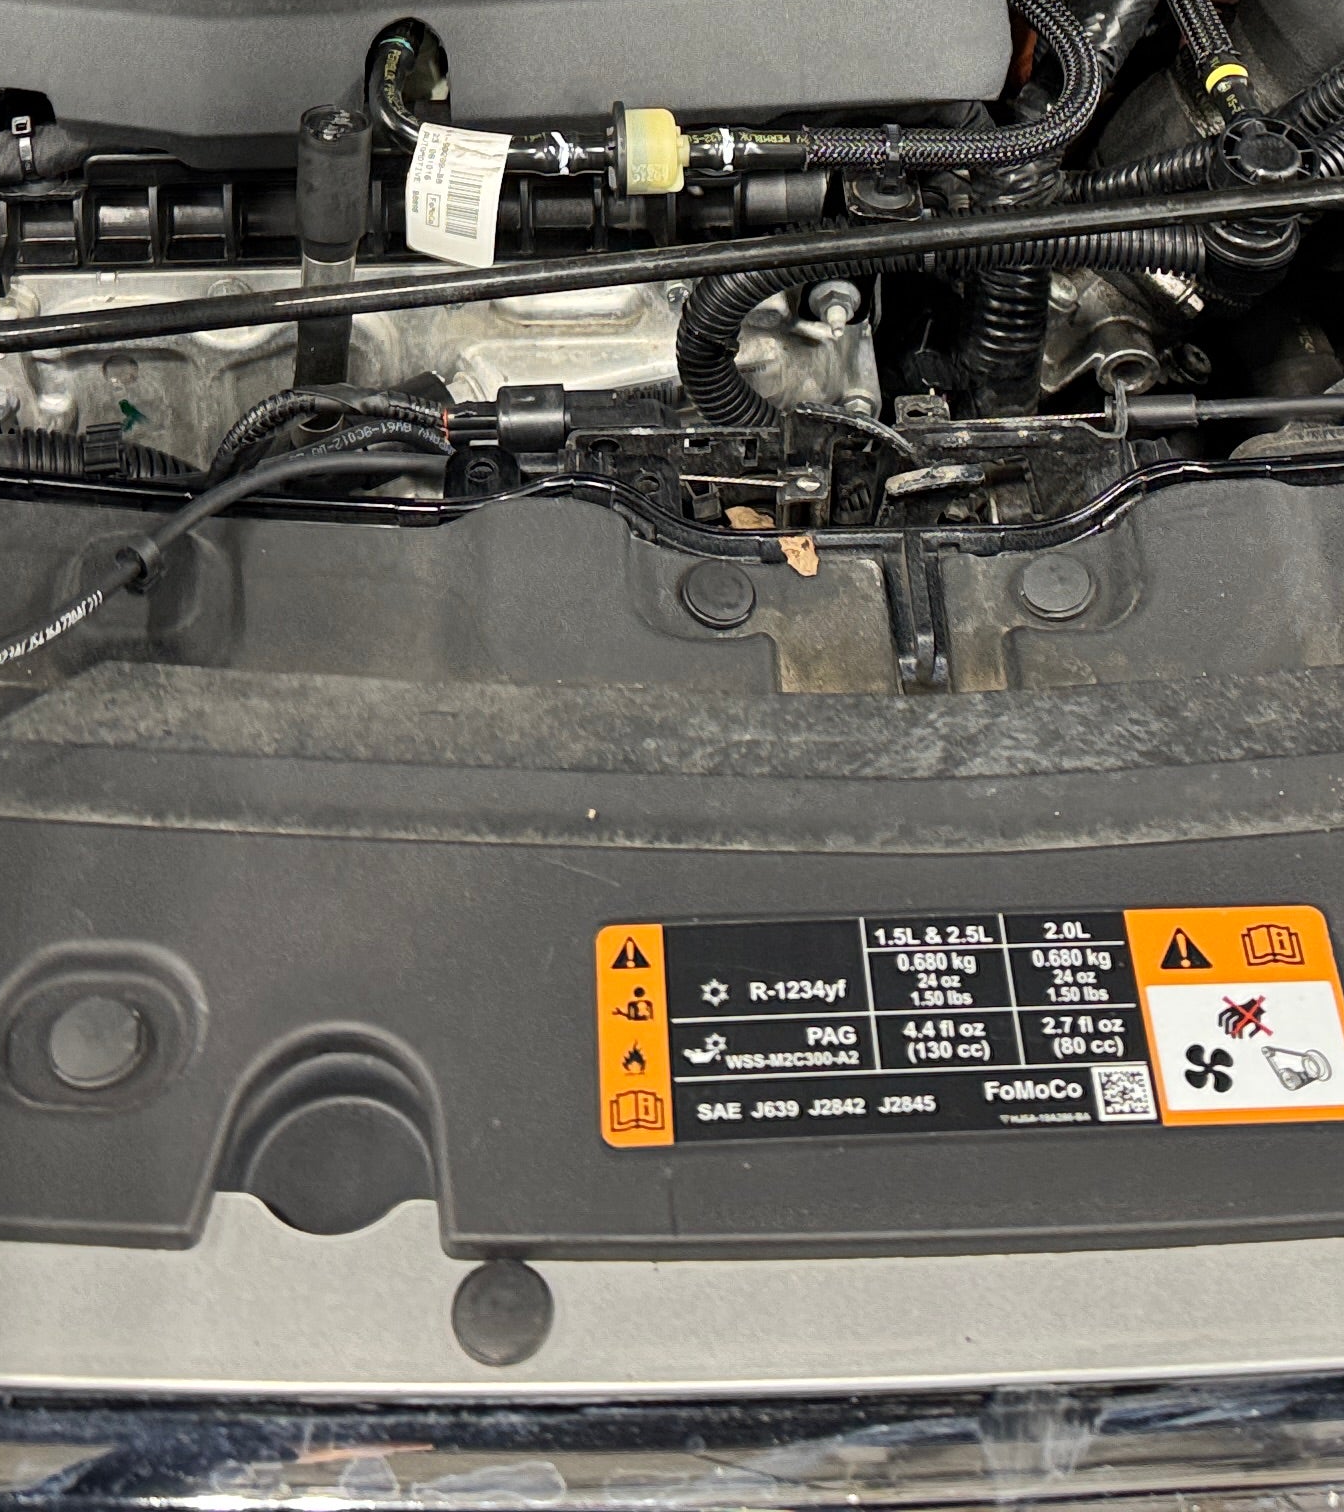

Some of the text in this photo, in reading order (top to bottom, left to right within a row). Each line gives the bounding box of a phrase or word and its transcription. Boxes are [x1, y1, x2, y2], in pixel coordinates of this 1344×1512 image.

[874, 926, 993, 946] 1.5L & 2.5L
[1043, 921, 1091, 939] 2.0L
[896, 951, 977, 974] 0.680 kg
[1031, 948, 1112, 970] 0.680 kg
[917, 973, 961, 989] 24 oz
[1052, 969, 1097, 985] 24 oz
[749, 979, 847, 1003] R-1234yf
[910, 989, 973, 1006] 1.50 lbs
[1046, 985, 1109, 1002] 1.50 lbs
[903, 1020, 986, 1038] 4.4 fl oz
[1041, 1015, 1126, 1035] 2.7 fl oz
[806, 1025, 857, 1046] PAG
[908, 1039, 991, 1064] (130 cc)
[1053, 1036, 1125, 1059] (80 cc)
[725, 1051, 860, 1070] WSS-M2C300-A2
[983, 1079, 1083, 1102] FoMoCo
[697, 1095, 937, 1121] SAE J639 J2842 J2845
